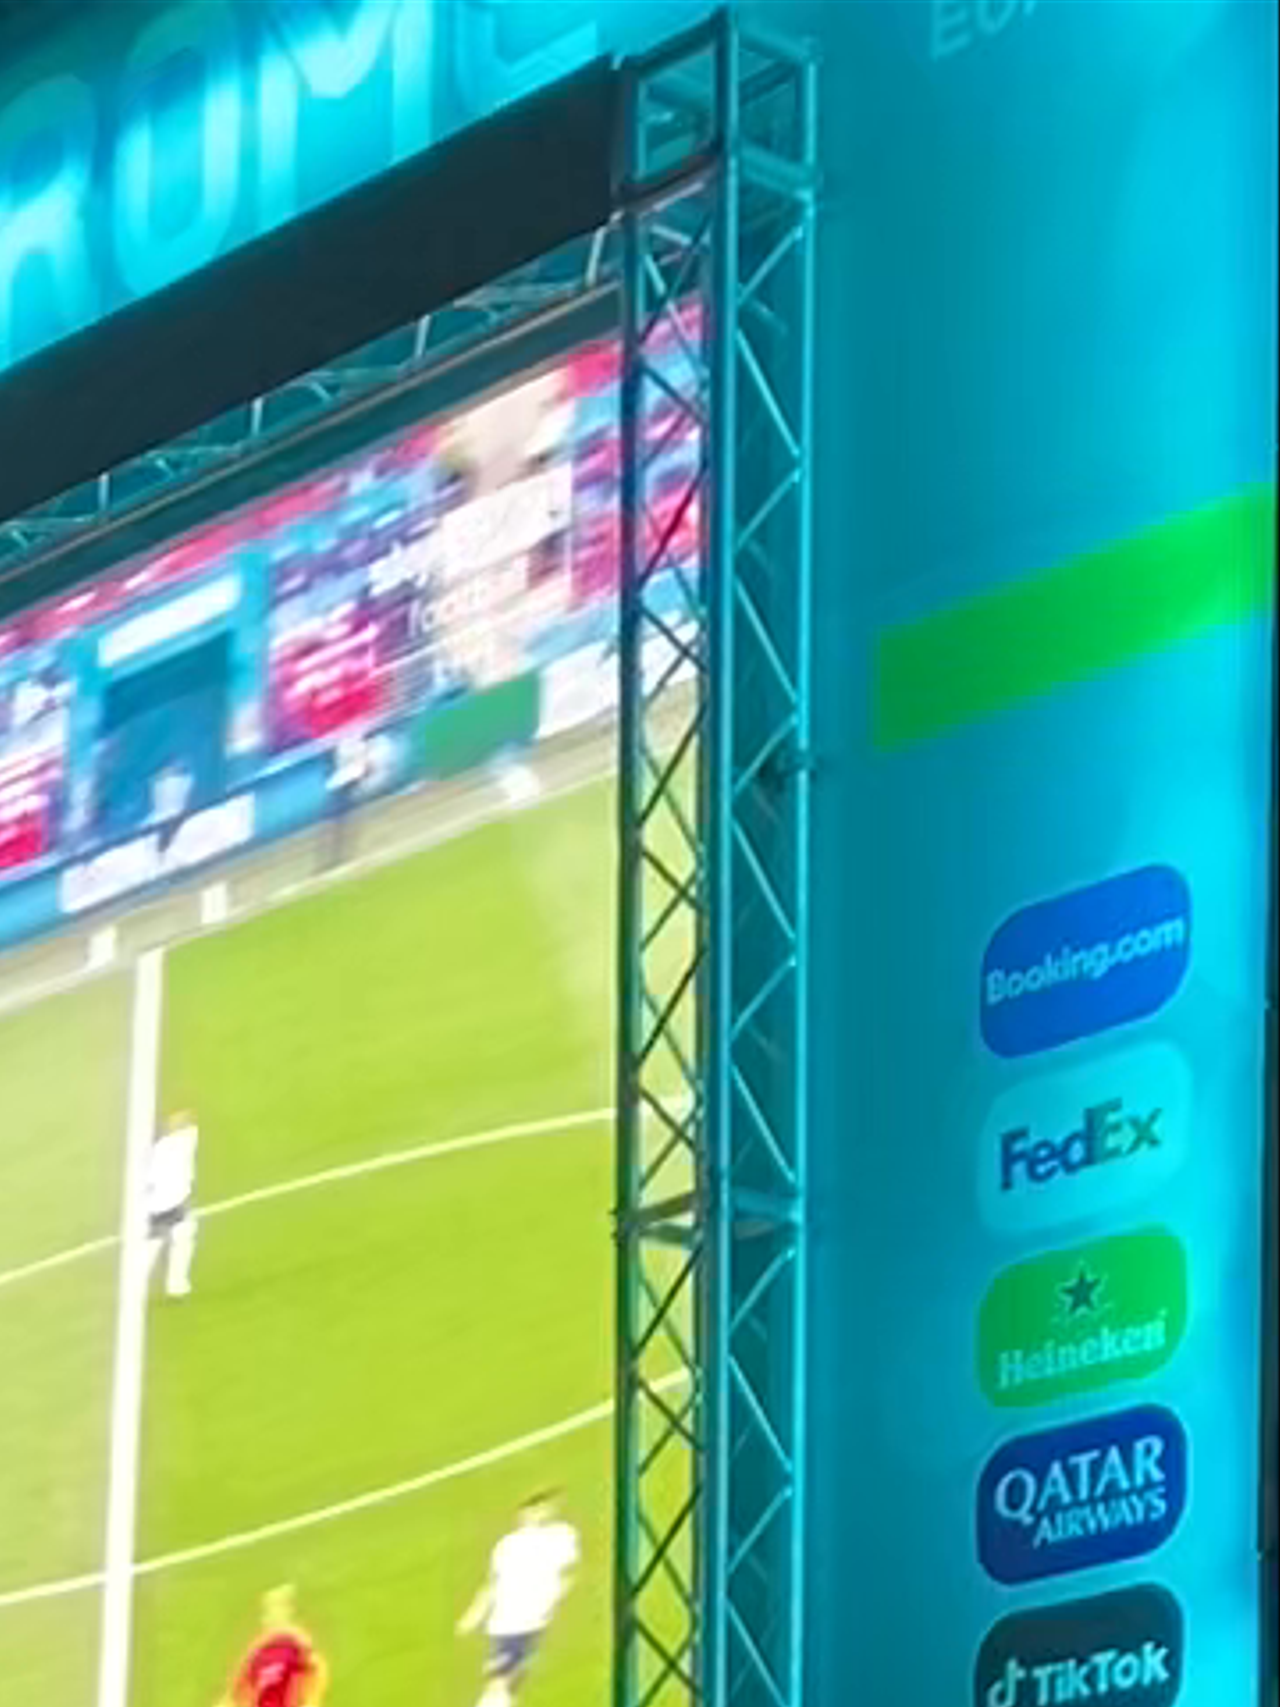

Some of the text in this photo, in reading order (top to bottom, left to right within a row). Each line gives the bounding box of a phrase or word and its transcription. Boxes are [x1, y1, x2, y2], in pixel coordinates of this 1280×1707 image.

[987, 915, 1186, 1007] Booking.com
[999, 1098, 1164, 1193] FedEx
[998, 1315, 1167, 1391] Heineken
[994, 1434, 1167, 1527] QATAR
[1032, 1485, 1167, 1550] AIRWAYS
[1032, 1640, 1171, 1707] TikTok
